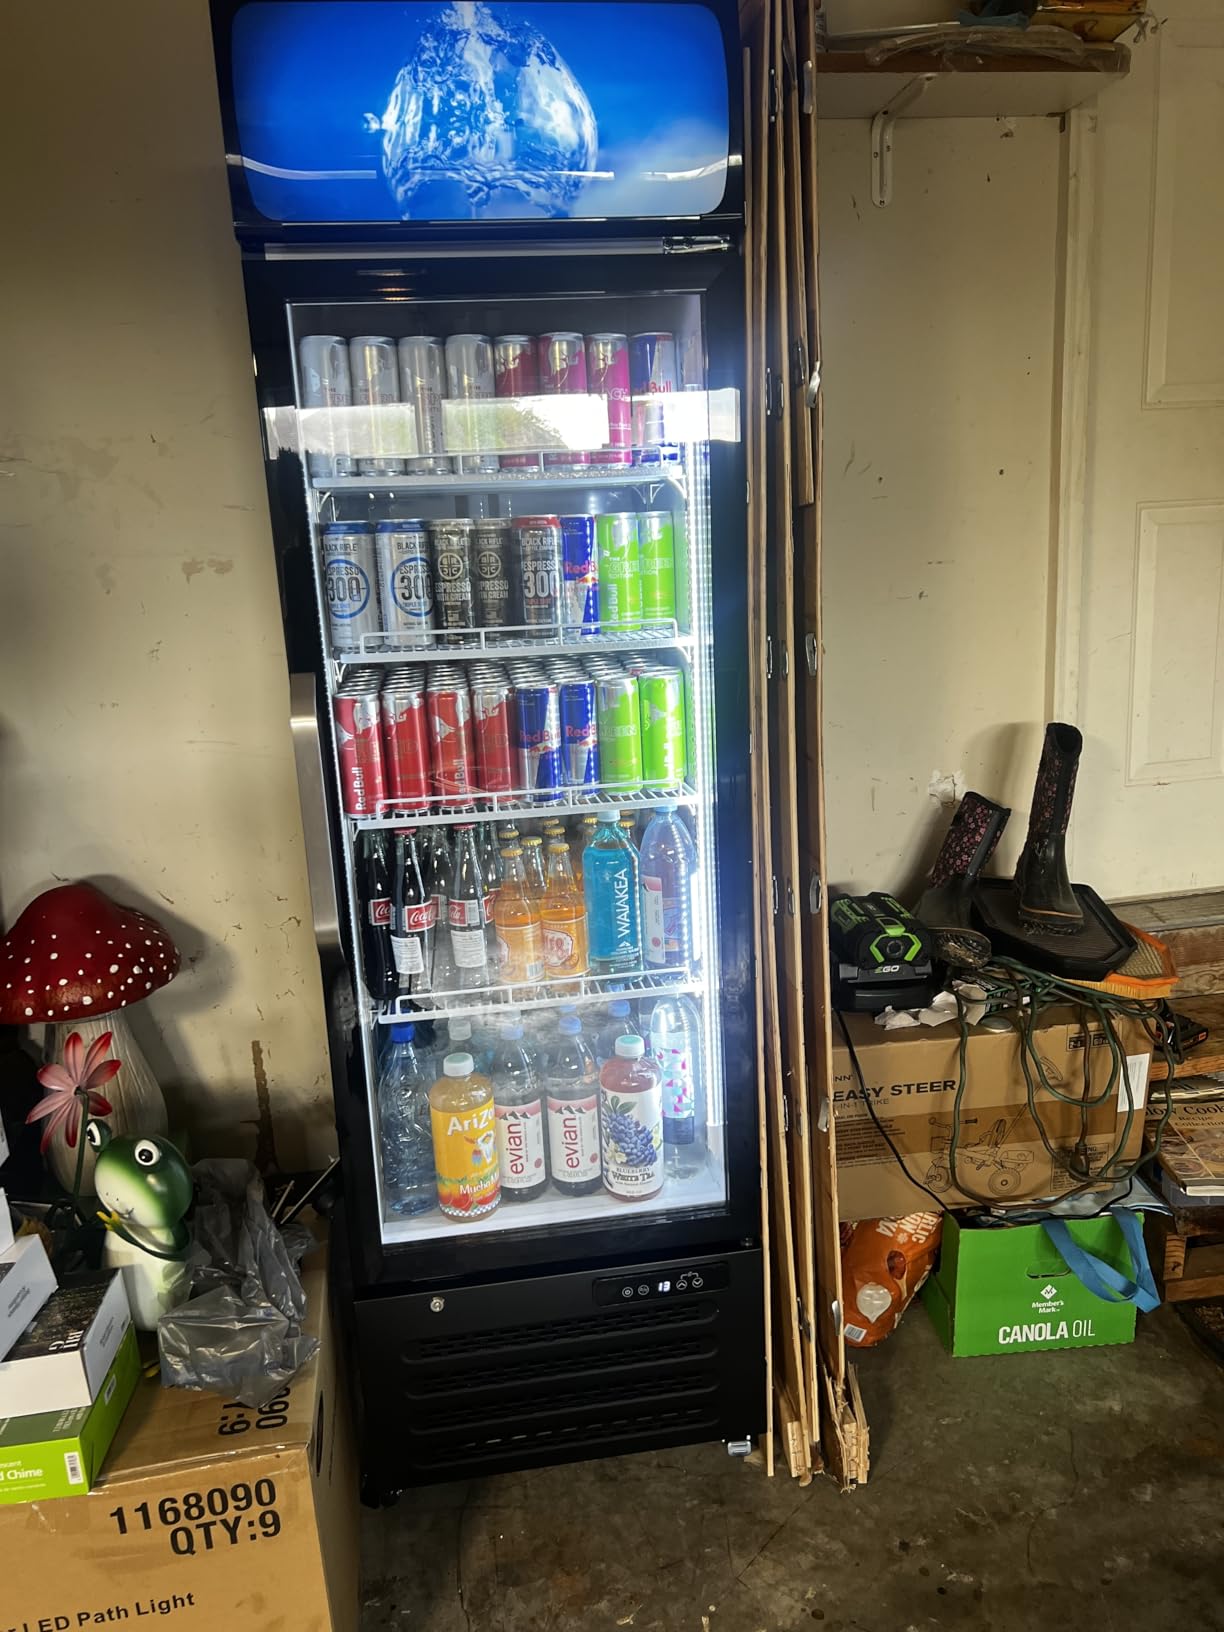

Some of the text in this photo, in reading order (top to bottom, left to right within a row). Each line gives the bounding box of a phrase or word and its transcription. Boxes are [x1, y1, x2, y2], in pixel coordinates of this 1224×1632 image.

[327, 576, 361, 602] 300
[523, 571, 560, 598] 300
[614, 867, 631, 939] WAIAKEA
[833, 1080, 957, 1102] EASY STEER
[506, 1122, 525, 1175] evian
[562, 1116, 580, 1169] evian
[658, 1281, 671, 1292] 13
[998, 1320, 1096, 1344] CANOLA OIL
[7, 1468, 43, 1480] Chime
[110, 1478, 276, 1534] 1168090
[170, 1509, 281, 1555] QTY:9
[77, 1606, 129, 1627] Path
[135, 1592, 195, 1615] Light
